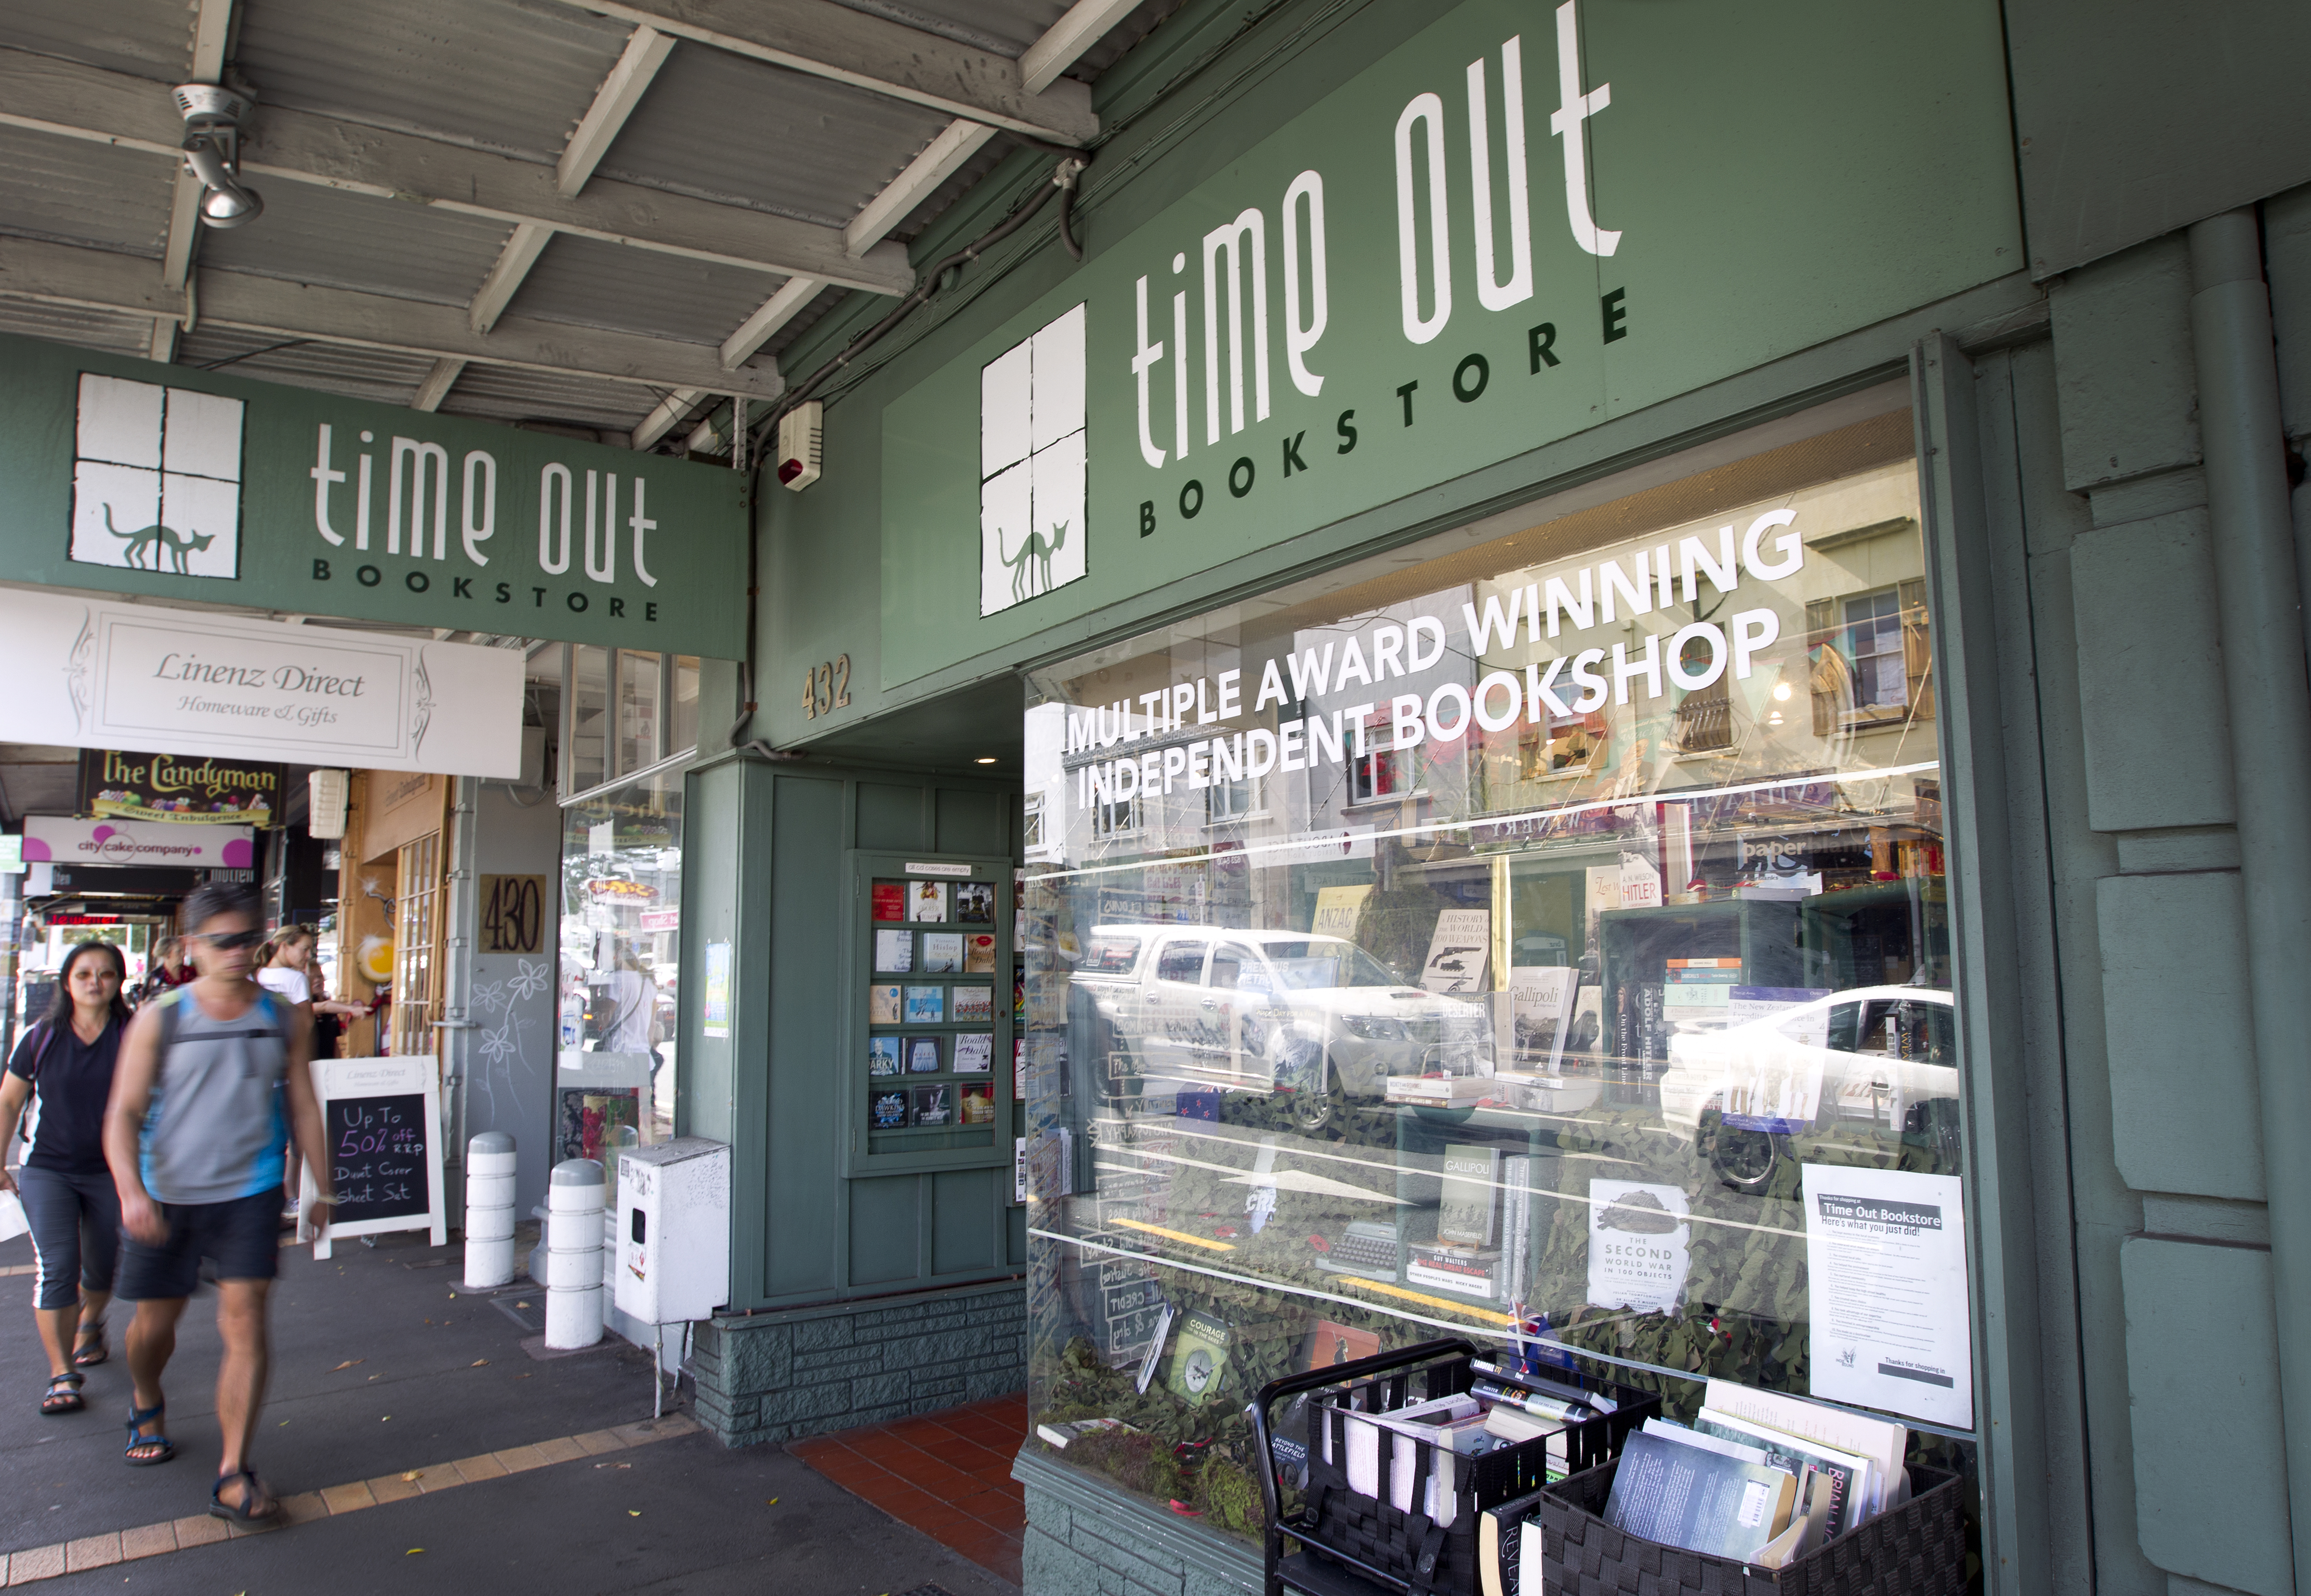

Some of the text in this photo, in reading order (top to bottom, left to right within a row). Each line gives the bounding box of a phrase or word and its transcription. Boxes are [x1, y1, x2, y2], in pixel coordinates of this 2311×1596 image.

[1132, 0, 1622, 468] time out
[1140, 287, 1627, 538] BOOKSTORE
[311, 423, 658, 588] time out
[313, 559, 657, 622] BOOKSTORE
[1068, 509, 1806, 751] MULTIPLE AWARD WINNING
[152, 653, 365, 698] Linenz Direct
[802, 653, 851, 721] 432
[176, 696, 339, 727] Homeware & Gifts
[1078, 608, 1780, 810] INDEPENDENT BOOKSHOP
[102, 750, 277, 799] The Candyman
[78, 841, 194, 857] city cake company
[1634, 872, 1654, 882] WILSON
[1622, 882, 1656, 901] HITLER
[485, 878, 540, 951] 430
[1317, 907, 1353, 929] ANZAC
[1446, 914, 1483, 923] HISTORY
[1449, 924, 1483, 933] WORLD
[932, 943, 958, 952] Hislop
[1434, 935, 1488, 944] 100 WEAPONS
[1239, 962, 1289, 973] PRECIOUS
[1509, 986, 1559, 1007] Gallipoli
[1273, 1008, 1286, 1017] DAY
[1442, 1002, 1486, 1018] DESERTER
[1644, 988, 1652, 1032] ADOLF
[1620, 1014, 1627, 1026] On
[960, 1034, 987, 1044] Roald
[964, 1044, 988, 1055] Dahl
[343, 1106, 401, 1129] Up To
[338, 1128, 416, 1158] 50% off
[378, 1161, 413, 1175] Cover
[1446, 1160, 1489, 1175] GALLIPOLI
[335, 1182, 411, 1204] Sheet Set
[1506, 1200, 1511, 1208] OF
[1517, 1199, 1523, 1207] OF
[1823, 1202, 1942, 1227] Time Out Bookstore
[1457, 1230, 1482, 1240] MASEFIELD
[1821, 1215, 1920, 1237] Here's what you just did!
[1605, 1244, 1672, 1260] SECOND
[1418, 1258, 1485, 1276] THE REAL GREAT ESCAPE
[1445, 1257, 1468, 1267] WALTERS
[1605, 1258, 1672, 1271] WORLD WAR
[1637, 1271, 1672, 1280] OBJECTS
[1190, 1319, 1226, 1341] COURAGE
[1199, 1331, 1207, 1340] THE
[1207, 1334, 1219, 1345] SKIES
[1473, 1359, 1503, 1375] LANDFALL 217
[1885, 1356, 1905, 1366] Thanks
[1915, 1362, 1939, 1374] shopping
[1272, 1441, 1305, 1459] ATTLEFIELD
[1275, 1437, 1305, 1452] BEYOND THE
[1828, 1467, 1845, 1515] BRIAN
